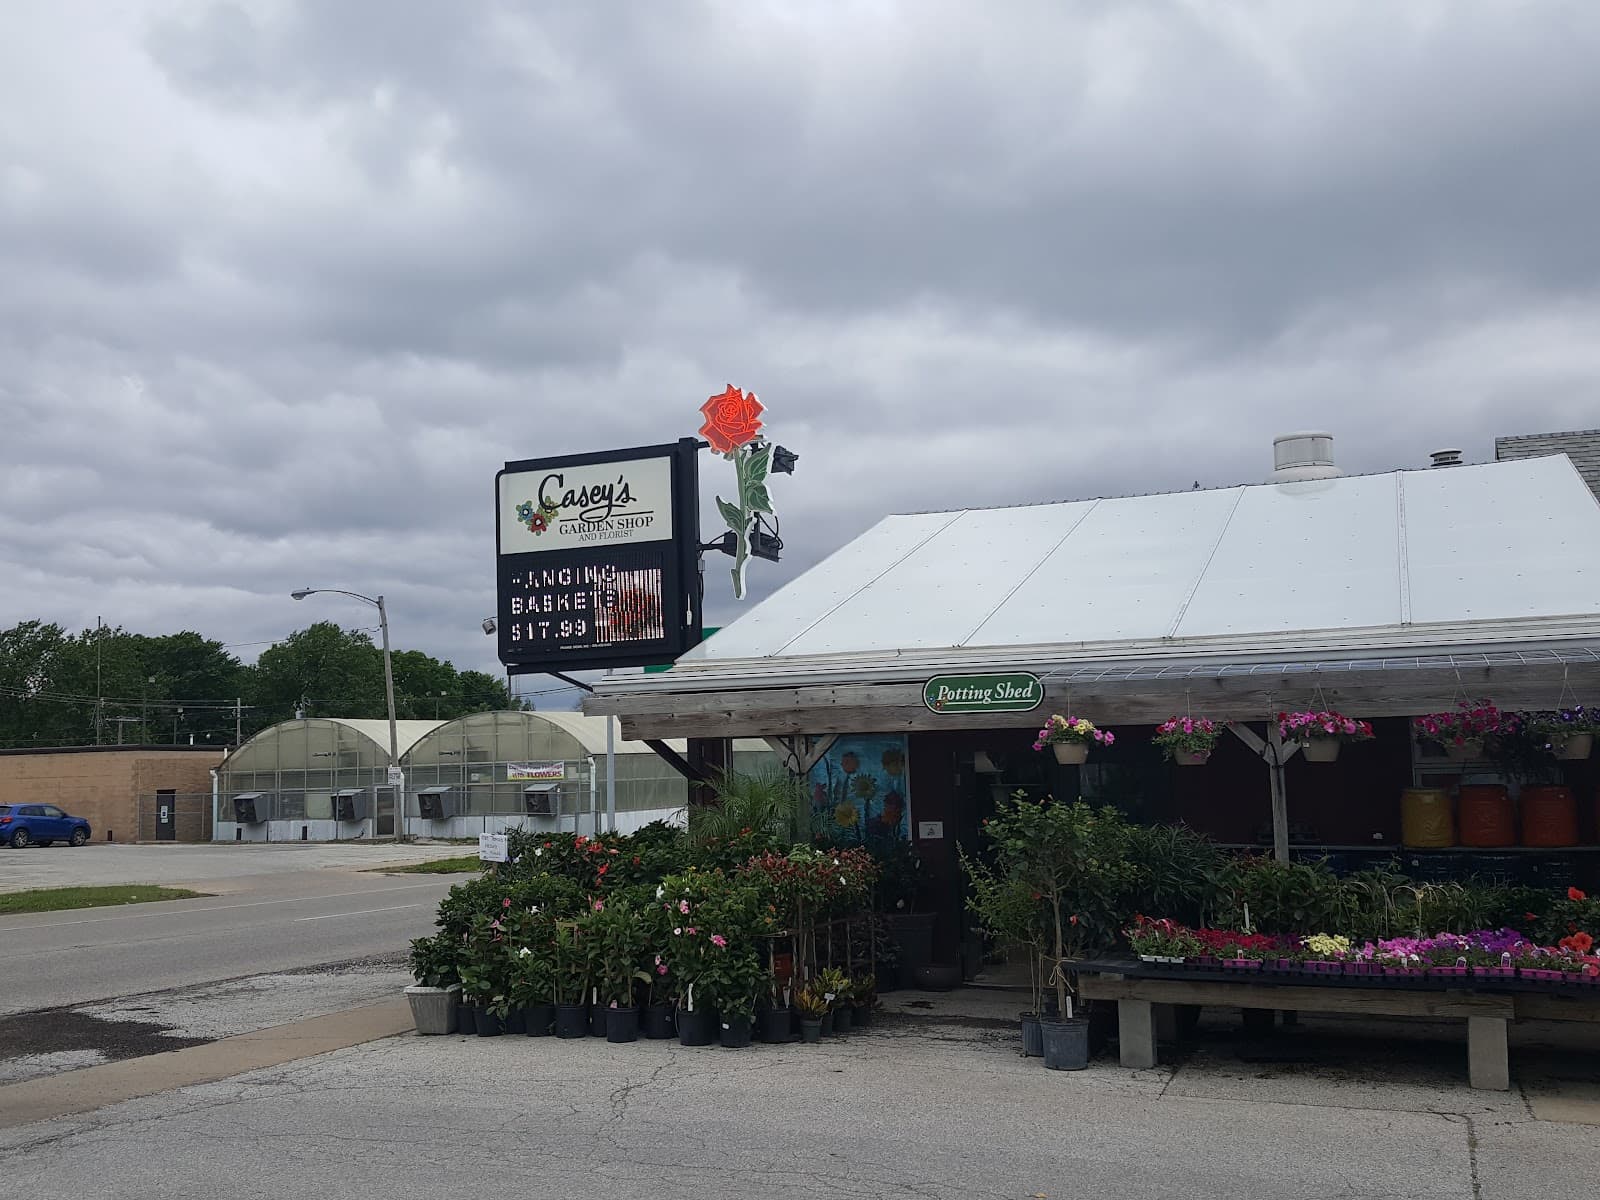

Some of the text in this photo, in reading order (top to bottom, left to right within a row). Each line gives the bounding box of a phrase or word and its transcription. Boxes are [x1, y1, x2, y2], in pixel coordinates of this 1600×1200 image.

[538, 474, 637, 522] Casey's
[559, 516, 654, 535] GARDEN SHOP
[578, 529, 635, 542] AND FLORIST
[937, 680, 1034, 705] Potting Shed
